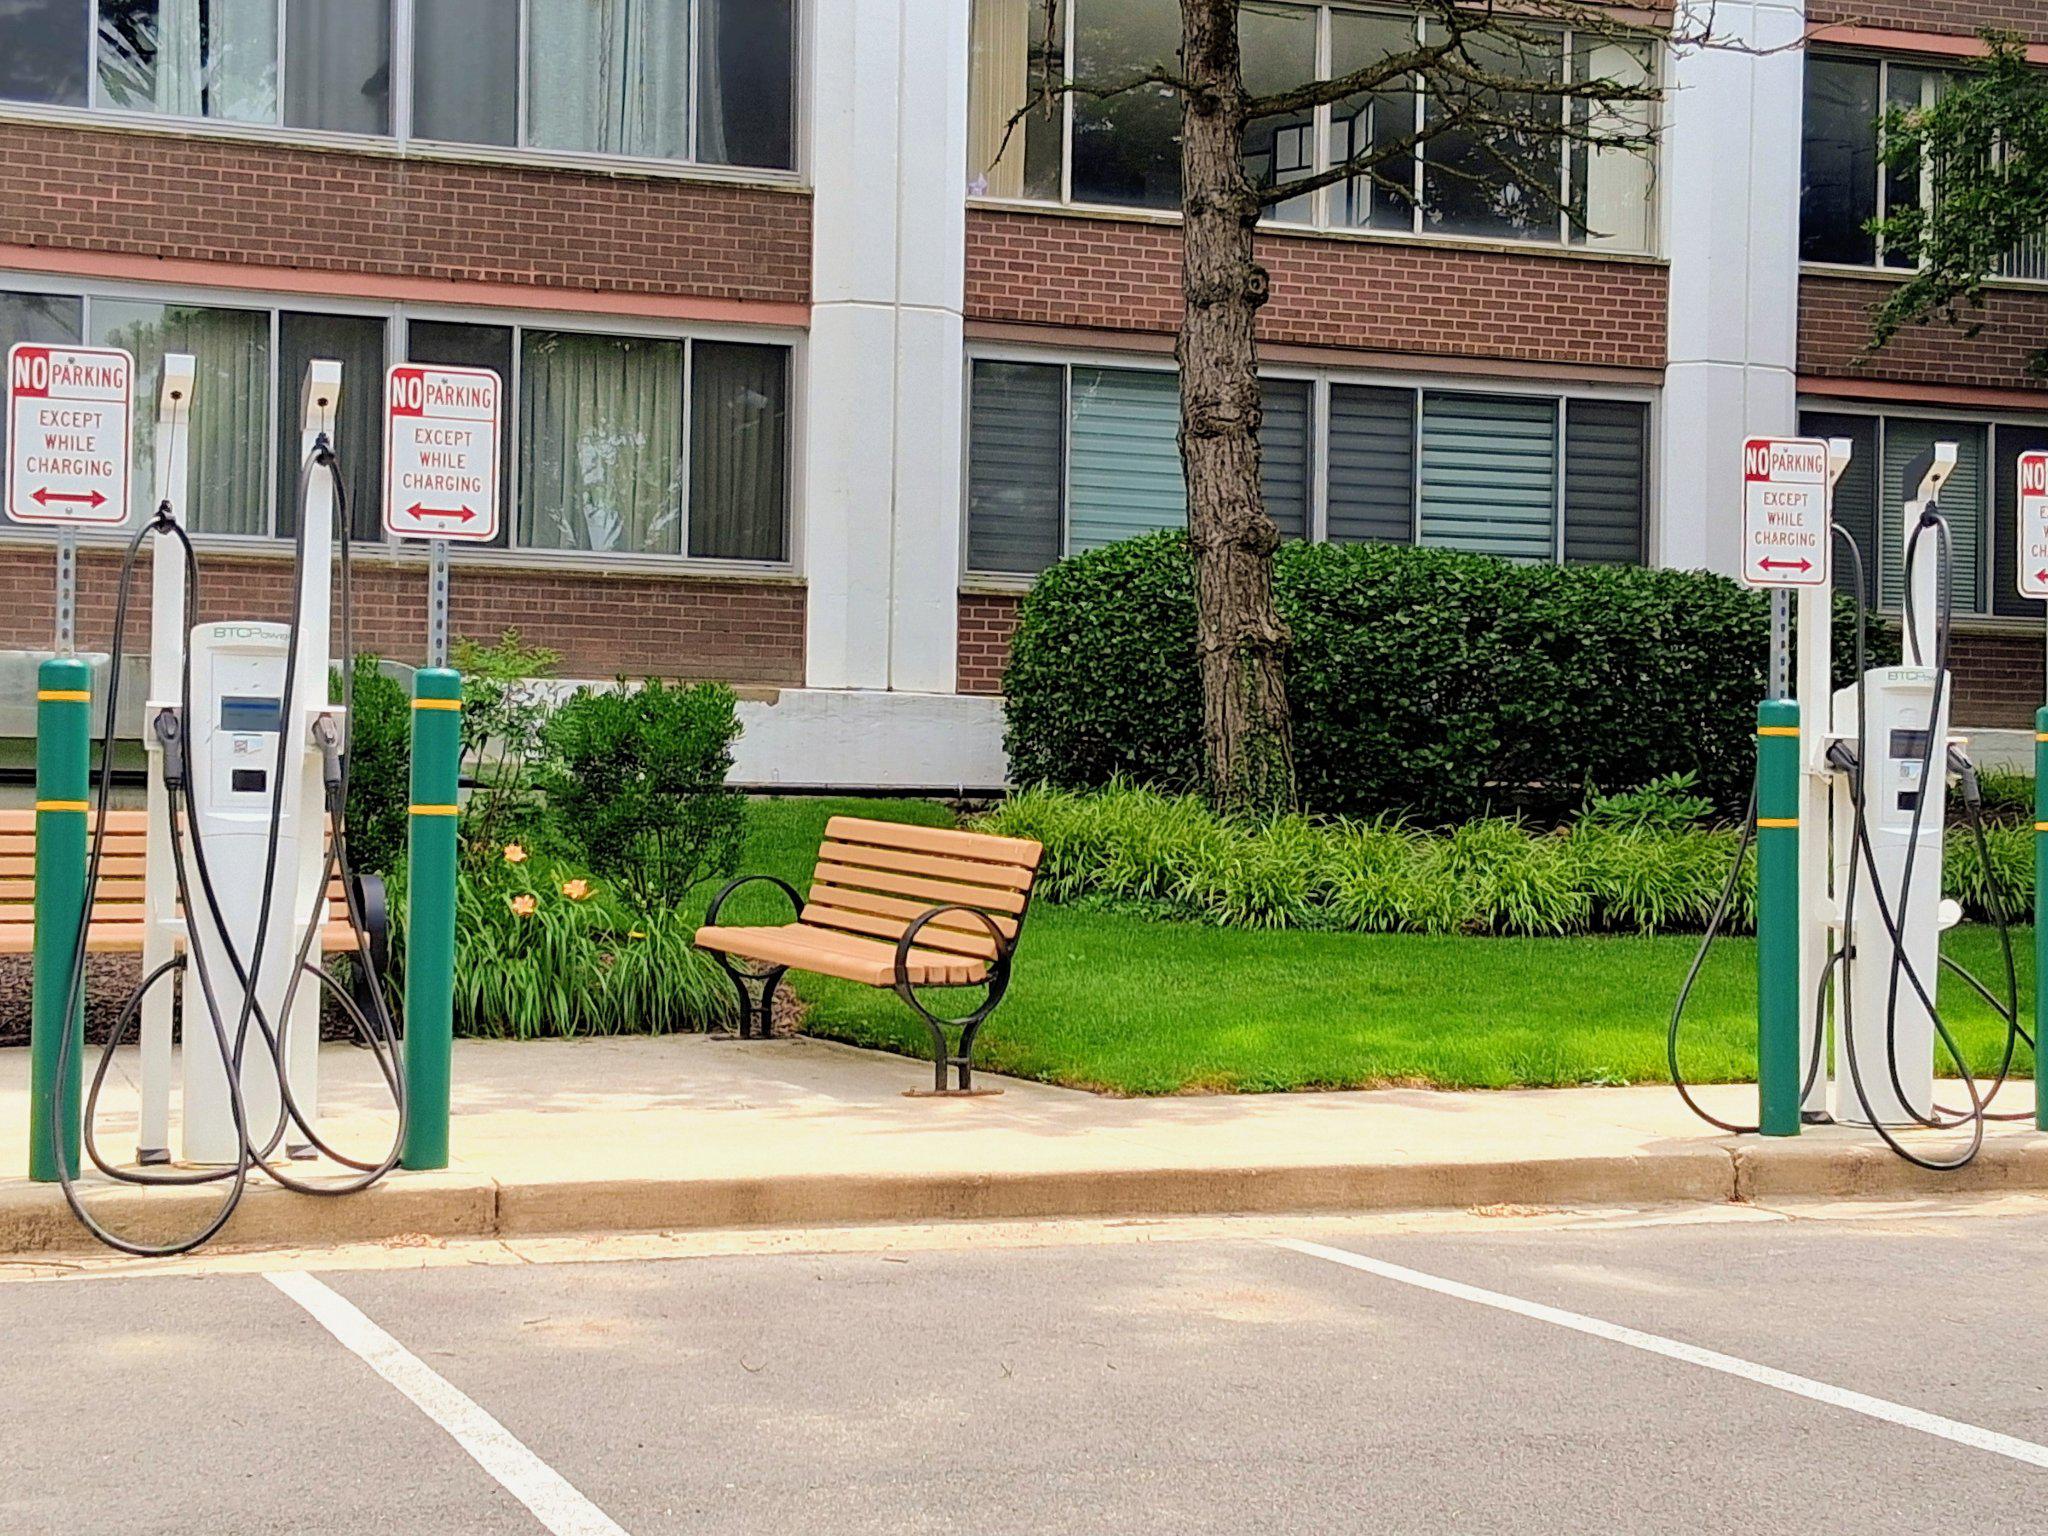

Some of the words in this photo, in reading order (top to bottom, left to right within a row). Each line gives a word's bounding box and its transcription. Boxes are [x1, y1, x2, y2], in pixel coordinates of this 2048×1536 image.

[15, 356, 48, 390] NO
[52, 364, 124, 389] PARKING
[393, 376, 422, 410] NO
[426, 384, 492, 409] PARKING
[40, 409, 103, 428] EXCEPT
[45, 434, 96, 452] WHILE
[415, 428, 473, 447] EXCEPT
[27, 457, 113, 477] CHARGING
[420, 451, 466, 469] WHILE
[1746, 447, 1769, 476] NO
[1772, 452, 1823, 474] PARKING
[403, 473, 481, 493] CHARGING
[2023, 462, 2045, 491] NO
[1764, 491, 1808, 507] EXCEPT
[1767, 512, 1804, 527] WHILE
[1755, 531, 1816, 547] CHARGING
[214, 626, 289, 641] BTCPowe
